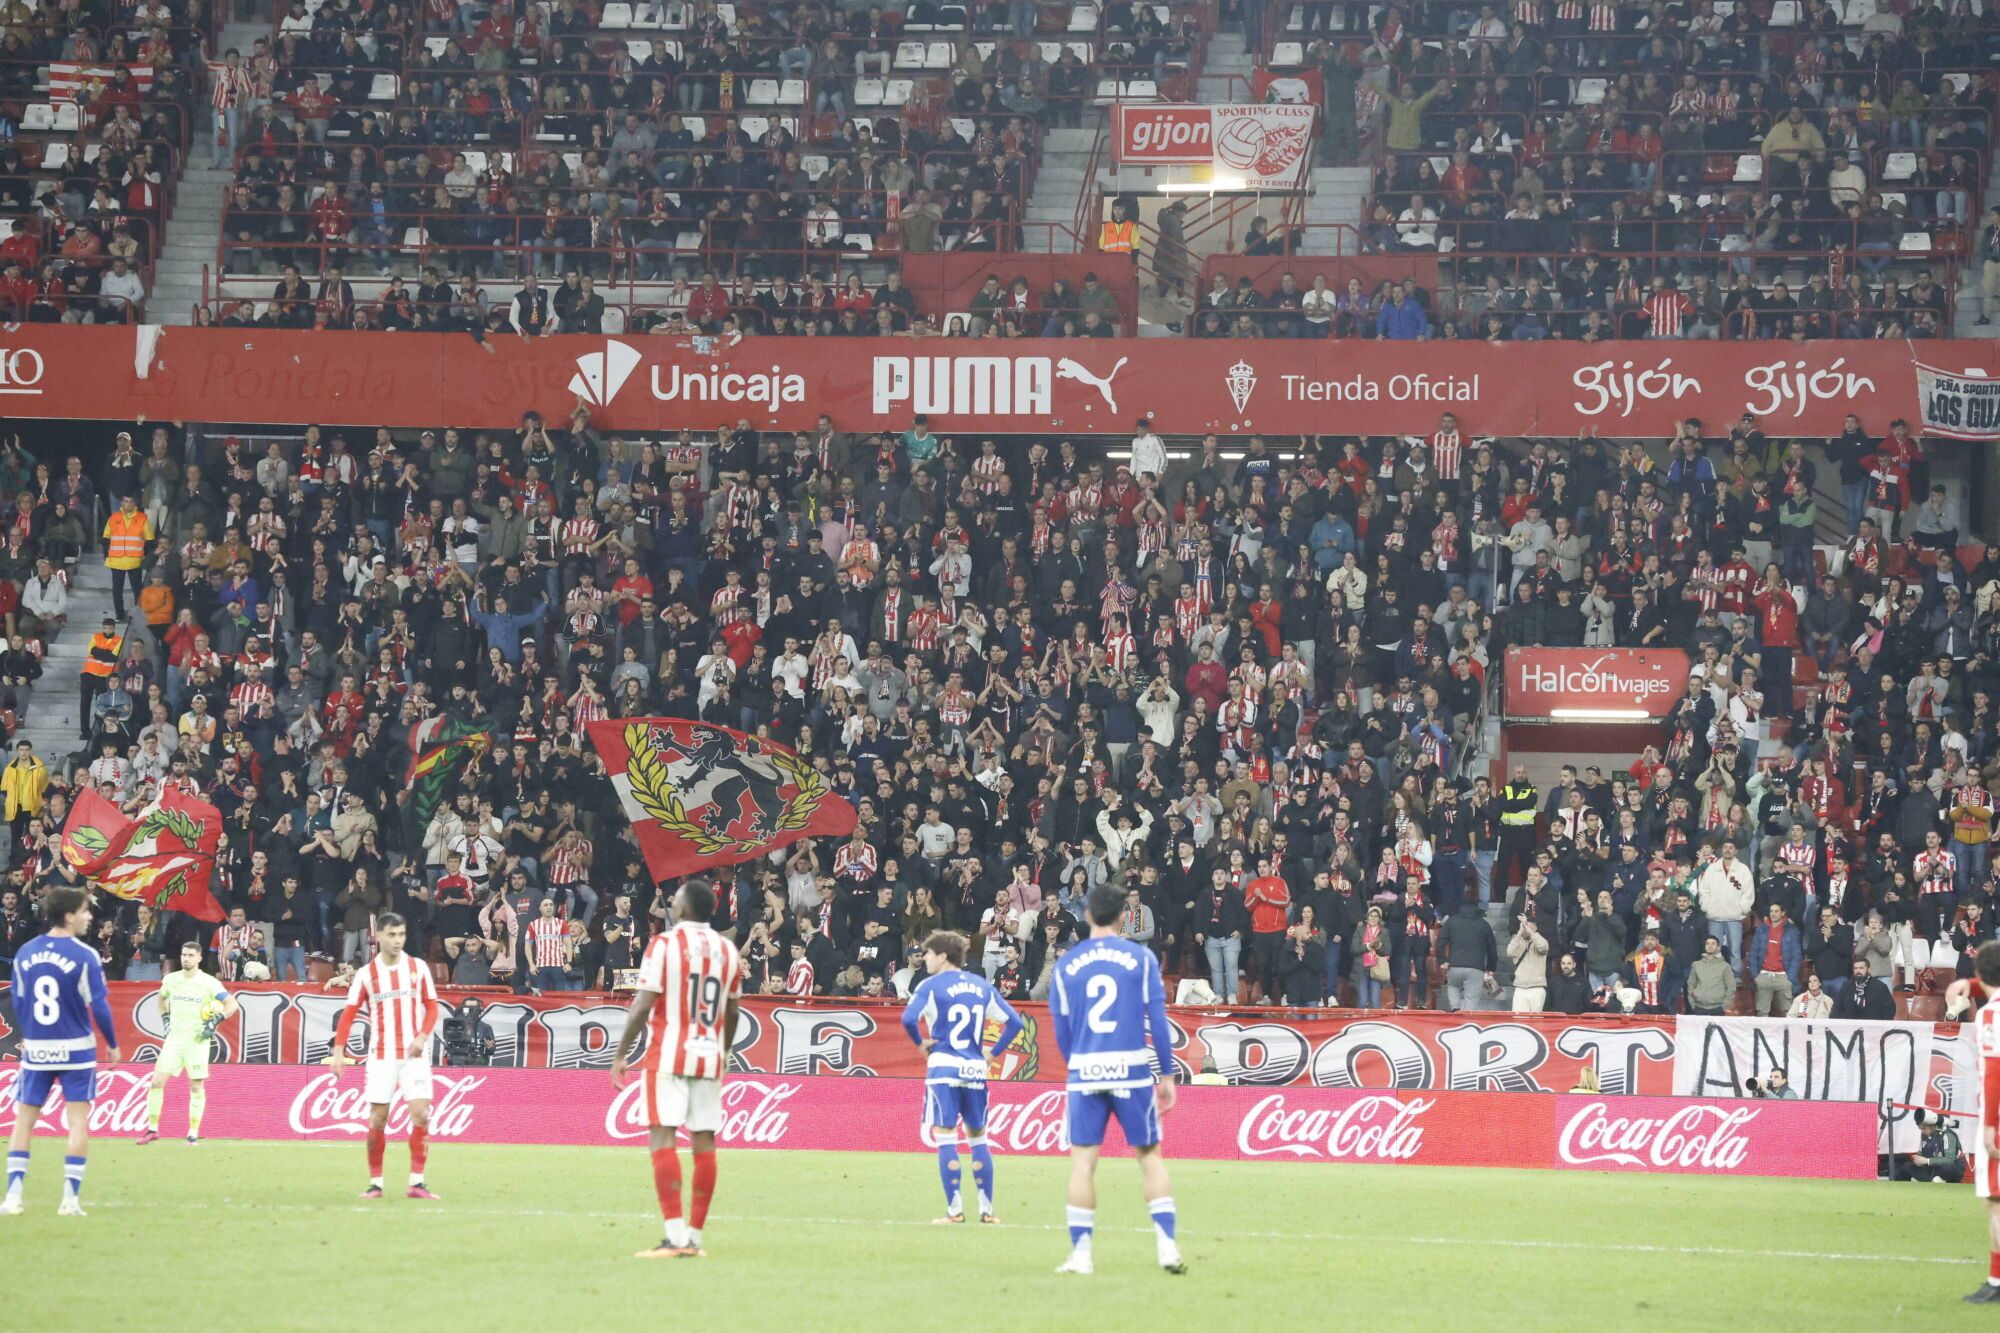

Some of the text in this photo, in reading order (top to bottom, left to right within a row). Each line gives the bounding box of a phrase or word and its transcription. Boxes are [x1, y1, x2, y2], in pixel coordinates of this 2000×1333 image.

[1132, 114, 1210, 150] gijon
[1216, 106, 1310, 117] SPORTING CLASS
[651, 364, 805, 412] Unicaja
[873, 356, 1052, 415] PUMA
[1281, 373, 1480, 401] Tienda Oficial
[1572, 357, 1701, 416] gijón
[1745, 357, 1876, 416] gijón
[1928, 391, 1962, 427] LOS
[1935, 378, 1960, 393] PEÑA
[33, 975, 60, 1026] 8
[688, 972, 722, 1027] 19
[1085, 973, 1118, 1034] 2
[947, 1003, 984, 1050] 21
[1237, 1093, 1437, 1159] Coca-Cola
[1558, 1102, 1762, 1170] Coca-Cola
